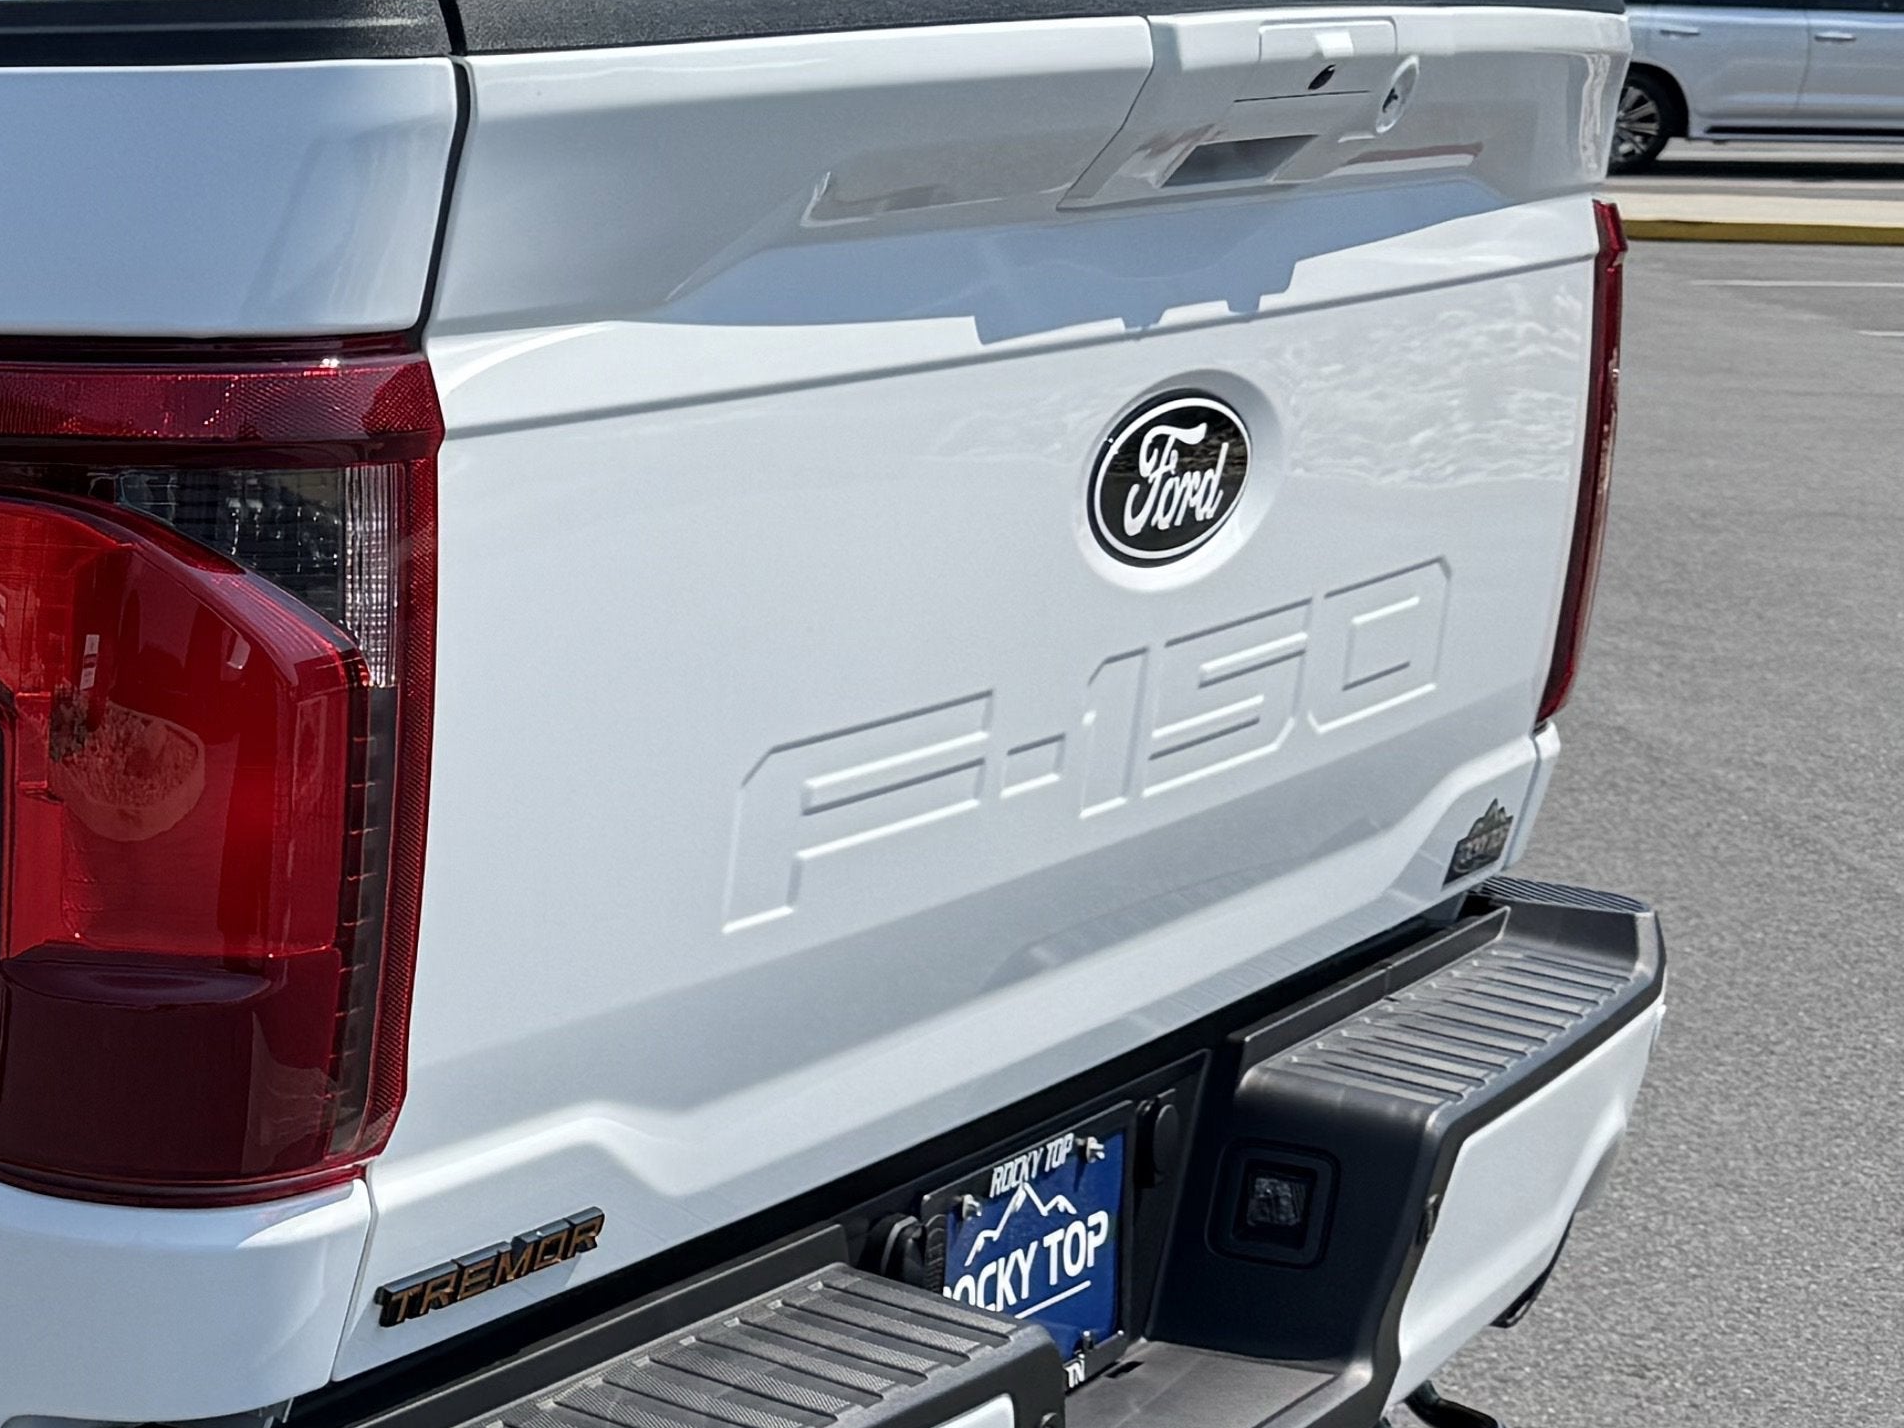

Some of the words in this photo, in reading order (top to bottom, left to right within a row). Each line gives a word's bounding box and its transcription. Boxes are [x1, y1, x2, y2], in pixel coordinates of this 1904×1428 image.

[1123, 422, 1230, 537] Ford
[722, 554, 1452, 935] F-150
[989, 1147, 1044, 1198] ROCKY
[1044, 1132, 1074, 1172] TOP
[373, 1206, 606, 1328] TREMOR
[942, 1240, 1039, 1312] OCKY
[1042, 1210, 1109, 1286] TOP
